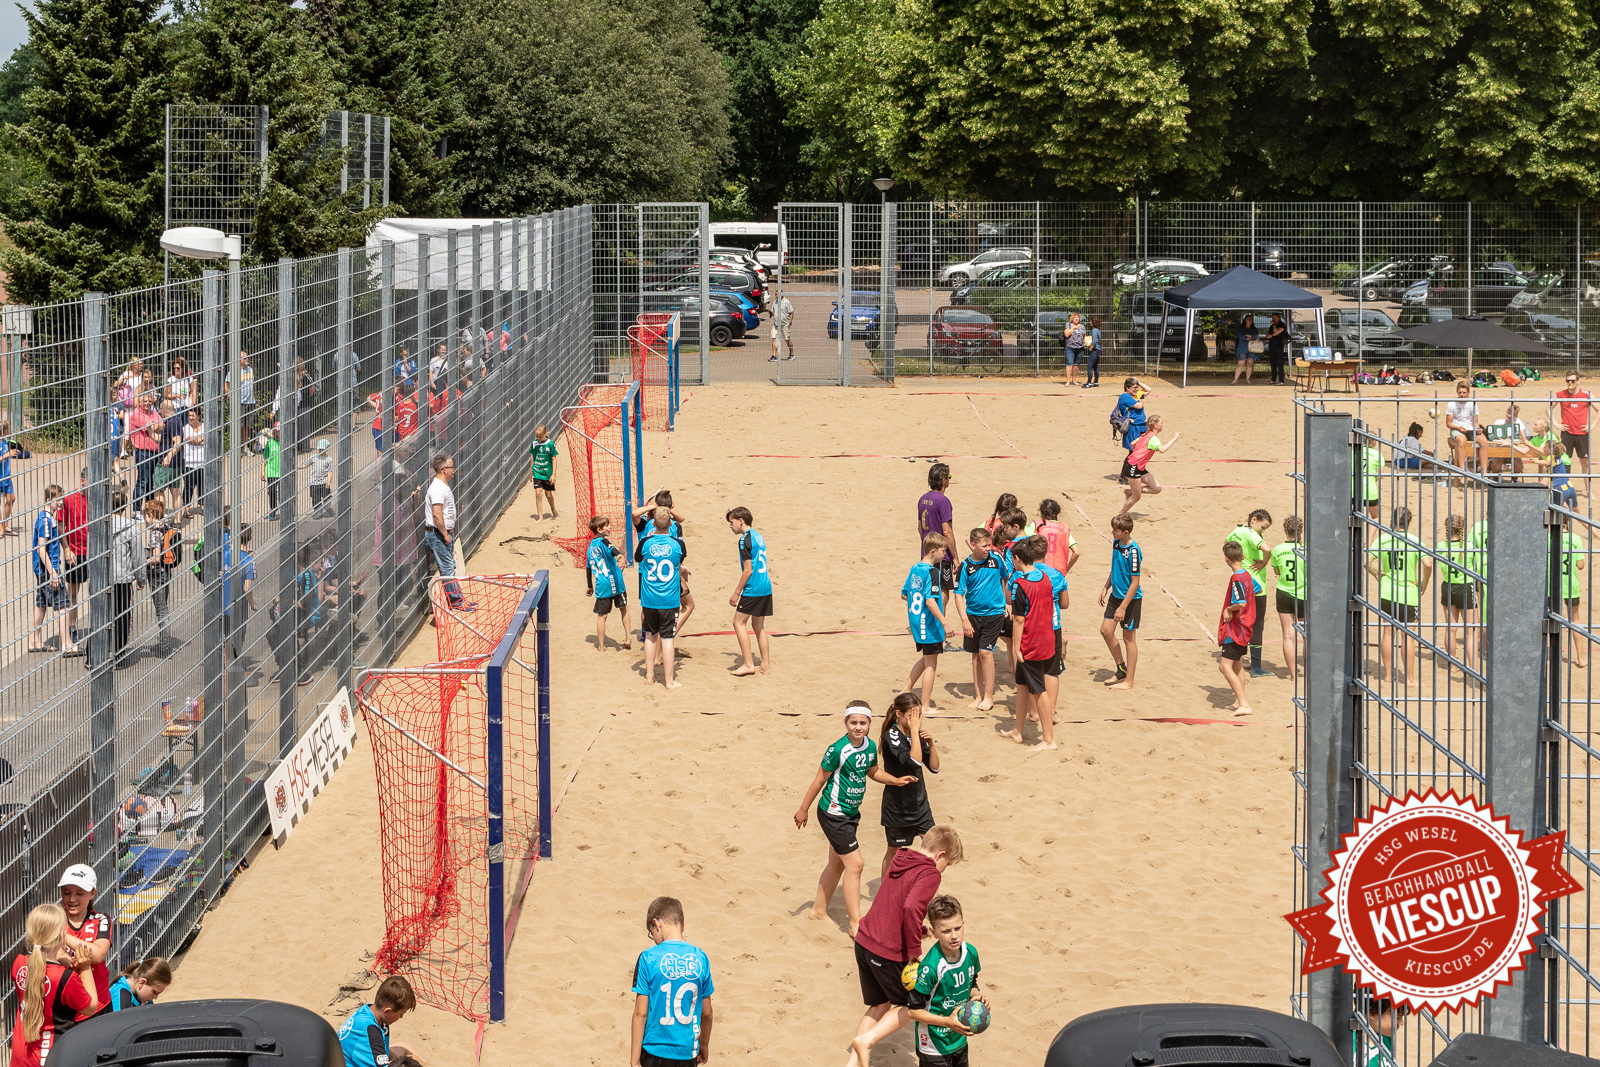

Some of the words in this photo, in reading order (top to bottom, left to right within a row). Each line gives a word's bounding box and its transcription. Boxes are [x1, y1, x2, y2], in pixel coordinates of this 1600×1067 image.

[1047, 533, 1057, 553] 8
[647, 559, 675, 582] 20
[1285, 560, 1297, 582] 3
[855, 752, 867, 768] 22
[952, 970, 966, 988] 10
[659, 980, 699, 1026] 10
